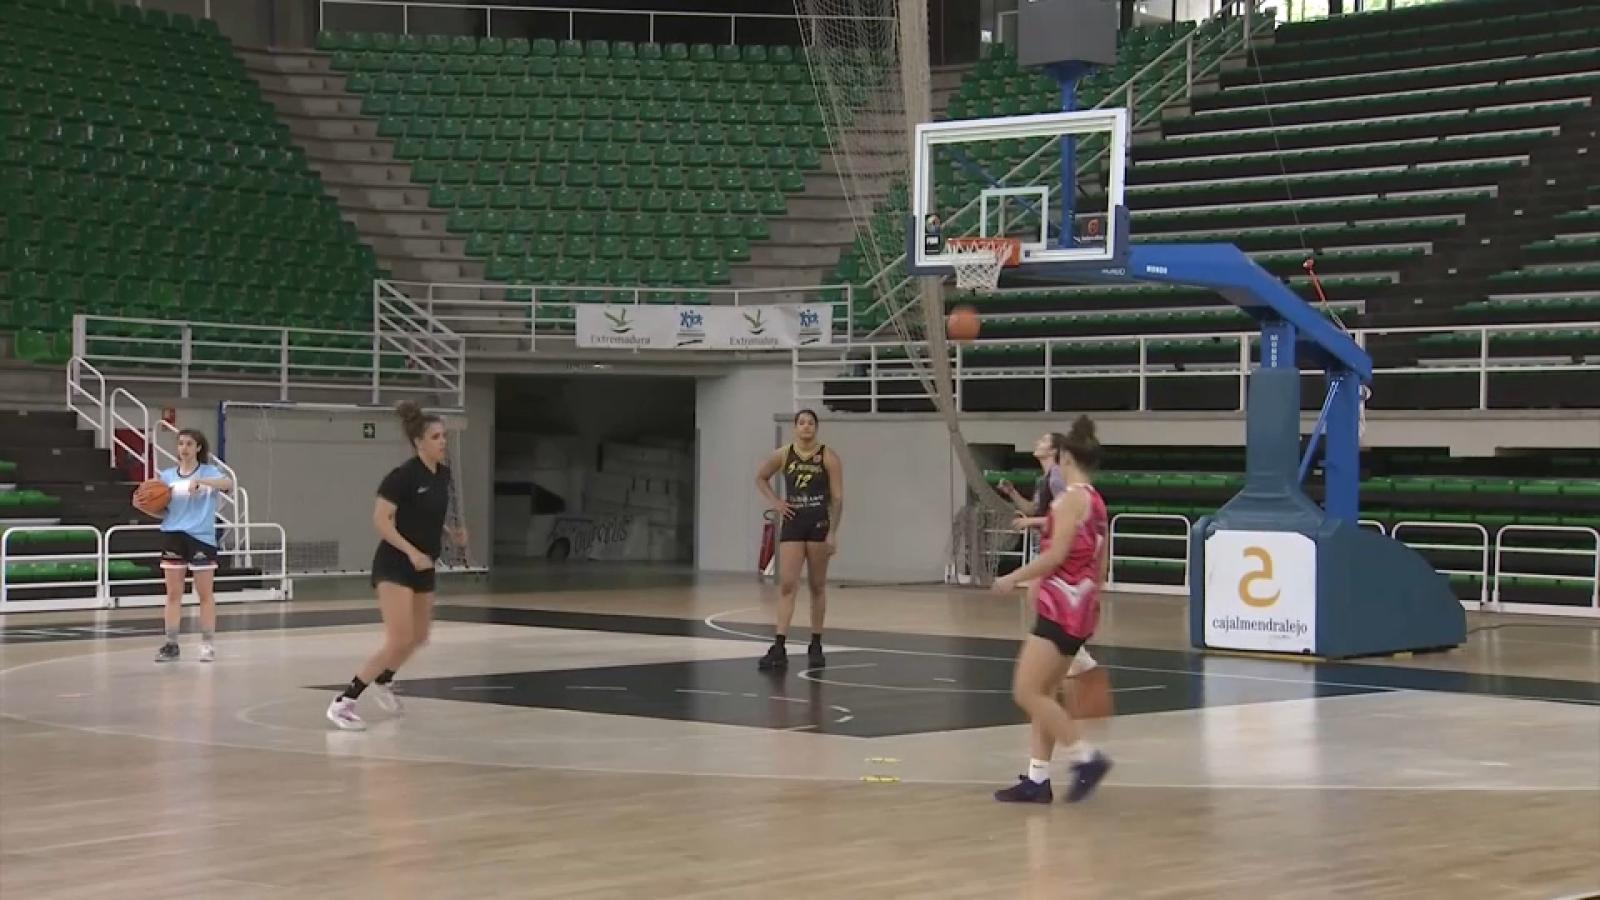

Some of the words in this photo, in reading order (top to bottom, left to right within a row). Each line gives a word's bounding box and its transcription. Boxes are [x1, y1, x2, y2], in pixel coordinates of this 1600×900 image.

[1145, 264, 1168, 275] MONDO
[590, 333, 651, 345] Extremadura
[794, 474, 813, 489] 12
[1212, 616, 1308, 637] cajalmendralejo
